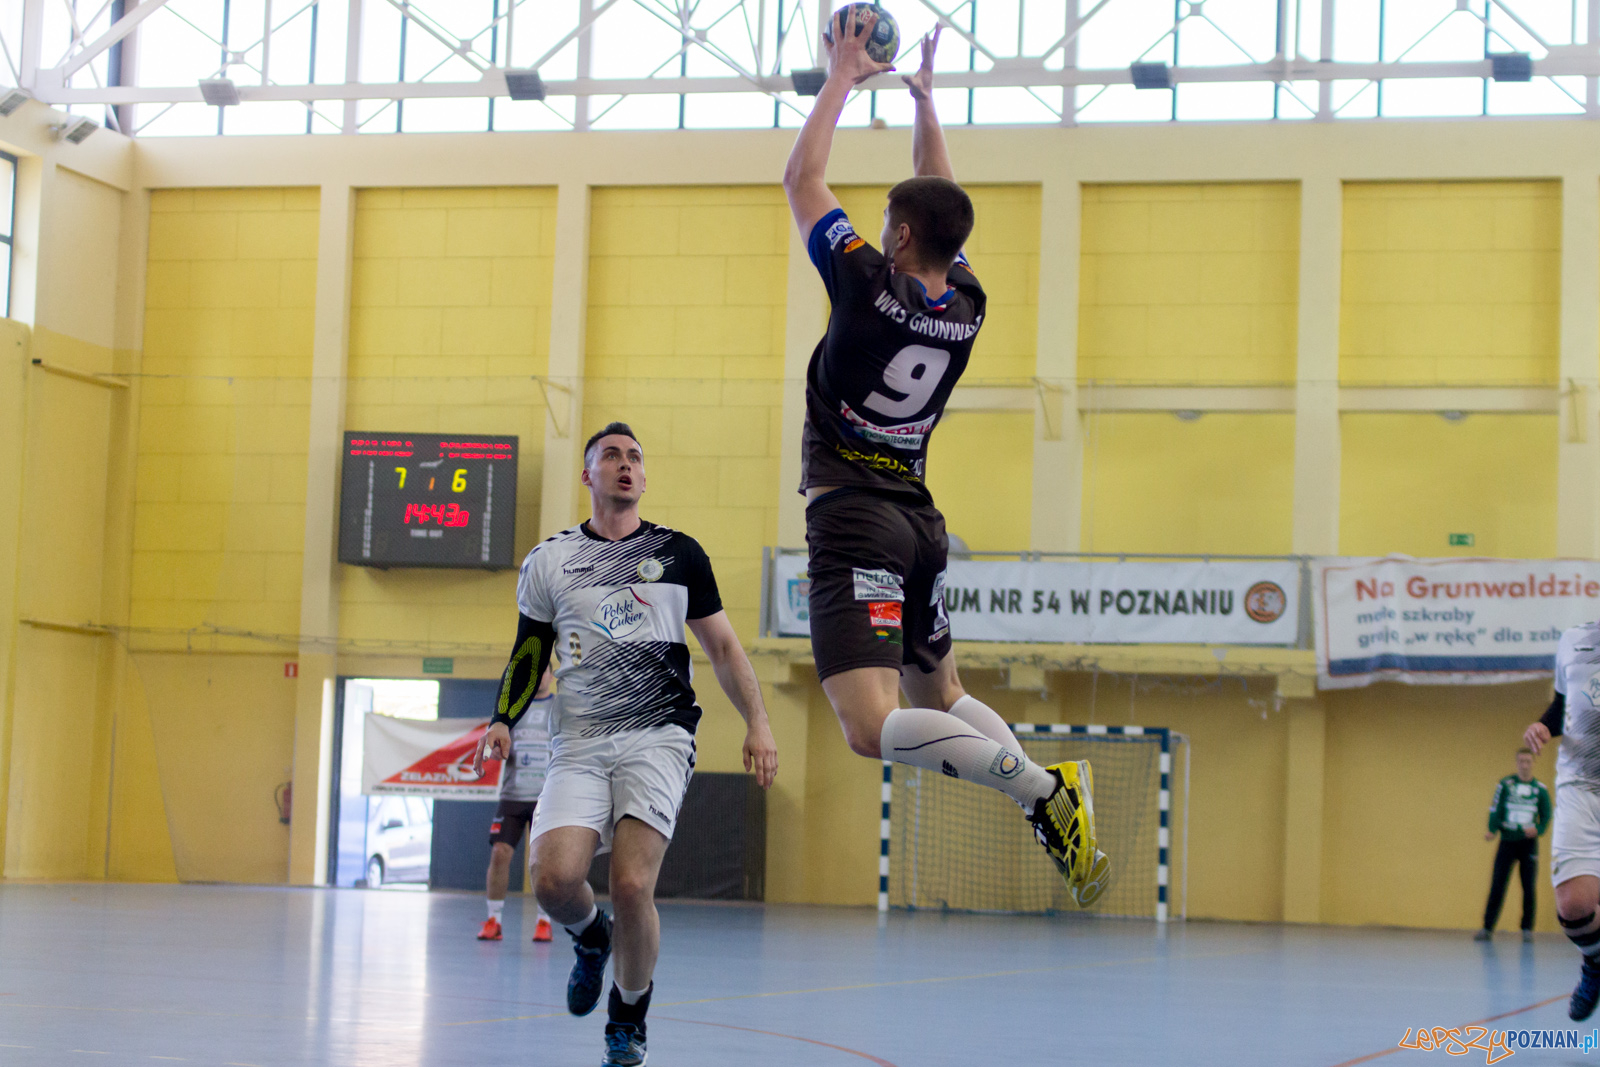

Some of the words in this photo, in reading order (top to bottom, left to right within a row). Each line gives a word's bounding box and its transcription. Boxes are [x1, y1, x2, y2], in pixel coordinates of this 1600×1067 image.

[874, 289, 907, 324] WKS
[863, 344, 951, 419] 9
[395, 467, 407, 489] 7
[452, 469, 468, 493] 6
[1356, 577, 1395, 601] Na
[1406, 574, 1600, 599] Grunwaldzie
[601, 600, 633, 621] Polski
[990, 588, 1022, 613] NR
[1032, 590, 1060, 615] 54
[1070, 589, 1090, 615] W
[1100, 589, 1233, 615] POZNANIU
[609, 612, 644, 630] Cukier
[1403, 607, 1475, 625] szkraby
[1494, 627, 1523, 642] dla
